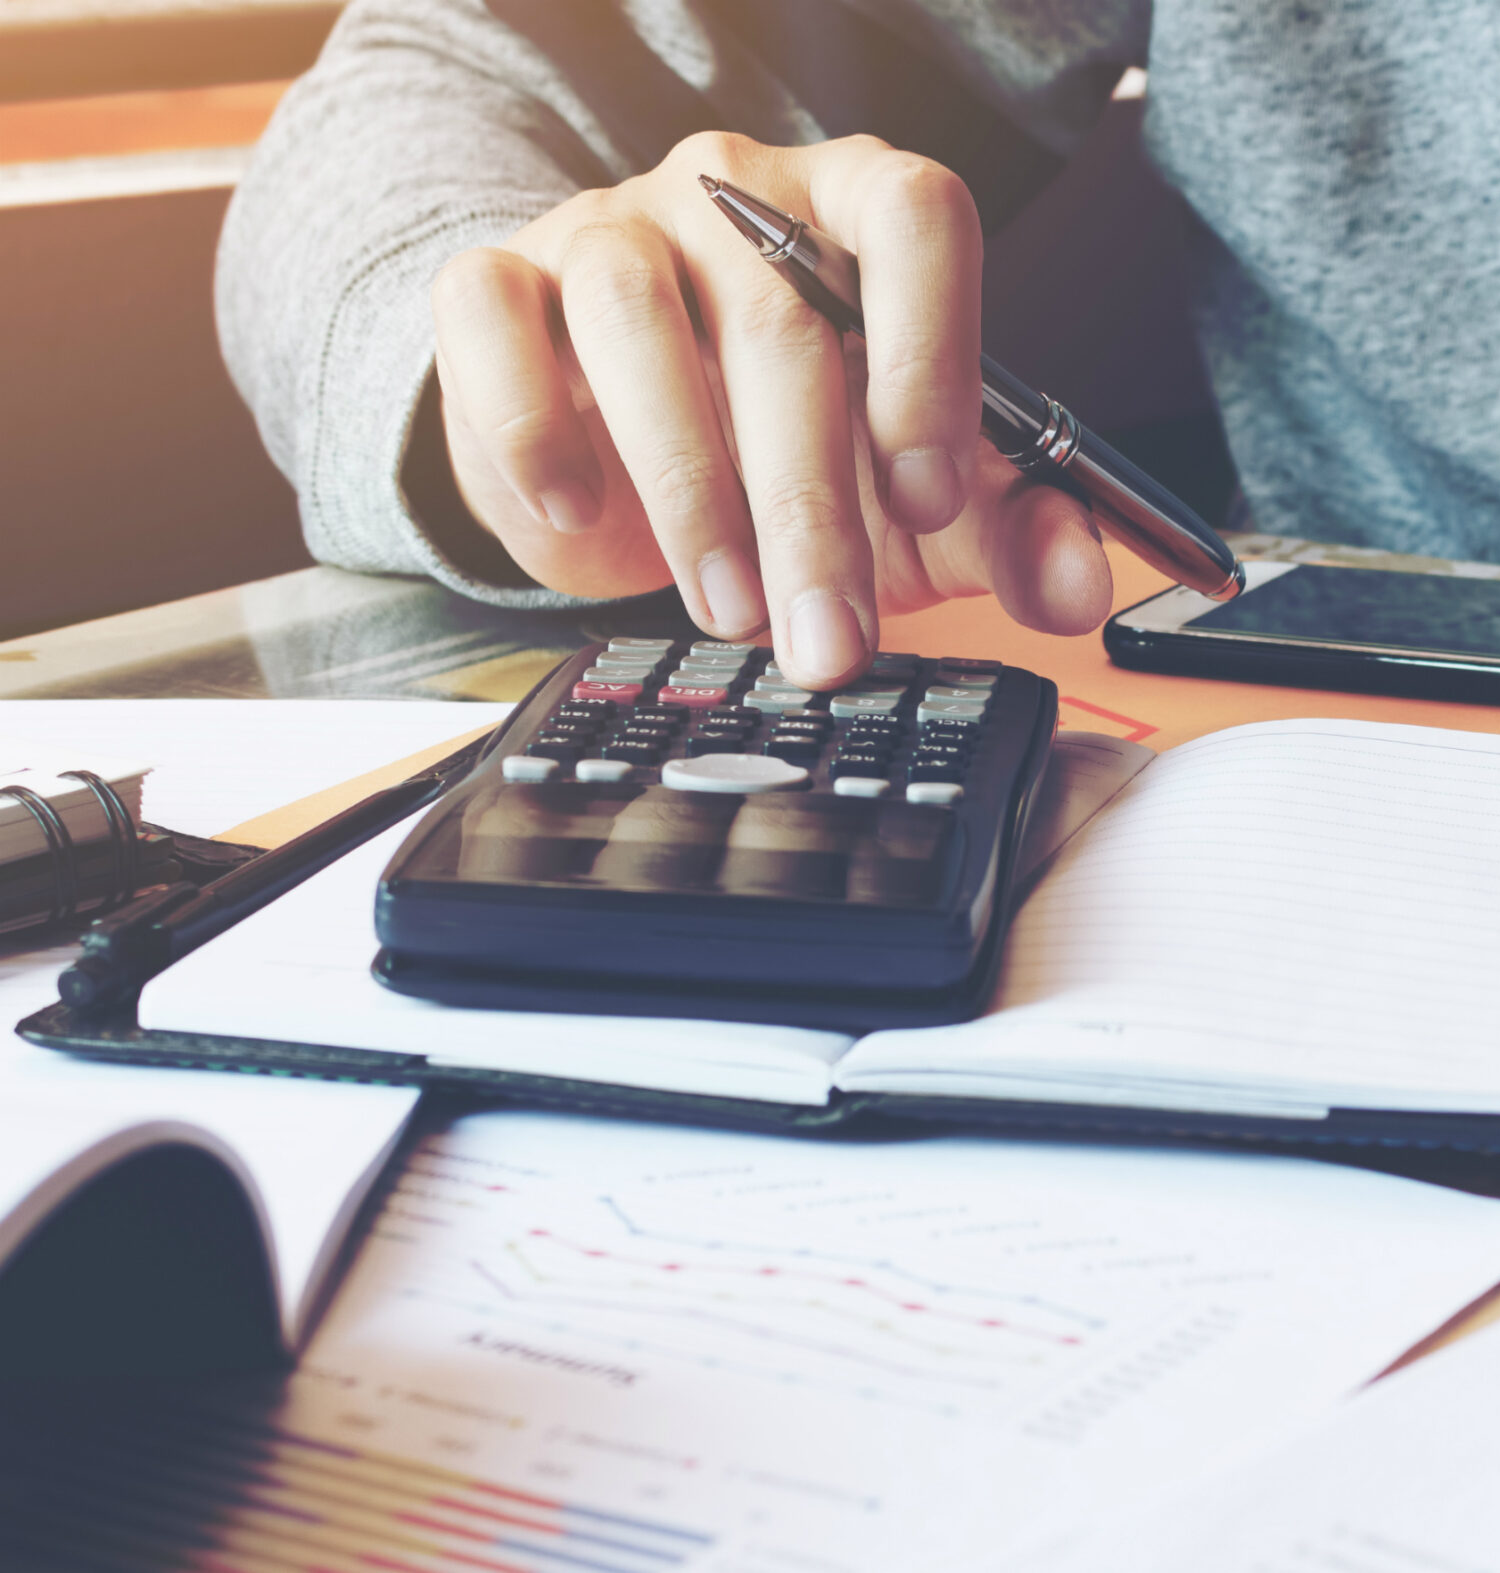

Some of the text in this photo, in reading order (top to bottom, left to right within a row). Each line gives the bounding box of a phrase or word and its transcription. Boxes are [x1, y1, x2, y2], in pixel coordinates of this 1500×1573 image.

[587, 682, 626, 691] AC
[671, 687, 716, 696] DEL
[951, 688, 969, 697] 4
[858, 698, 876, 706] 8
[943, 704, 961, 713] 7
[709, 717, 739, 725] sin
[857, 714, 898, 723] ENG
[933, 719, 968, 727] RCL
[779, 721, 814, 730] hyp
[626, 727, 658, 735] log
